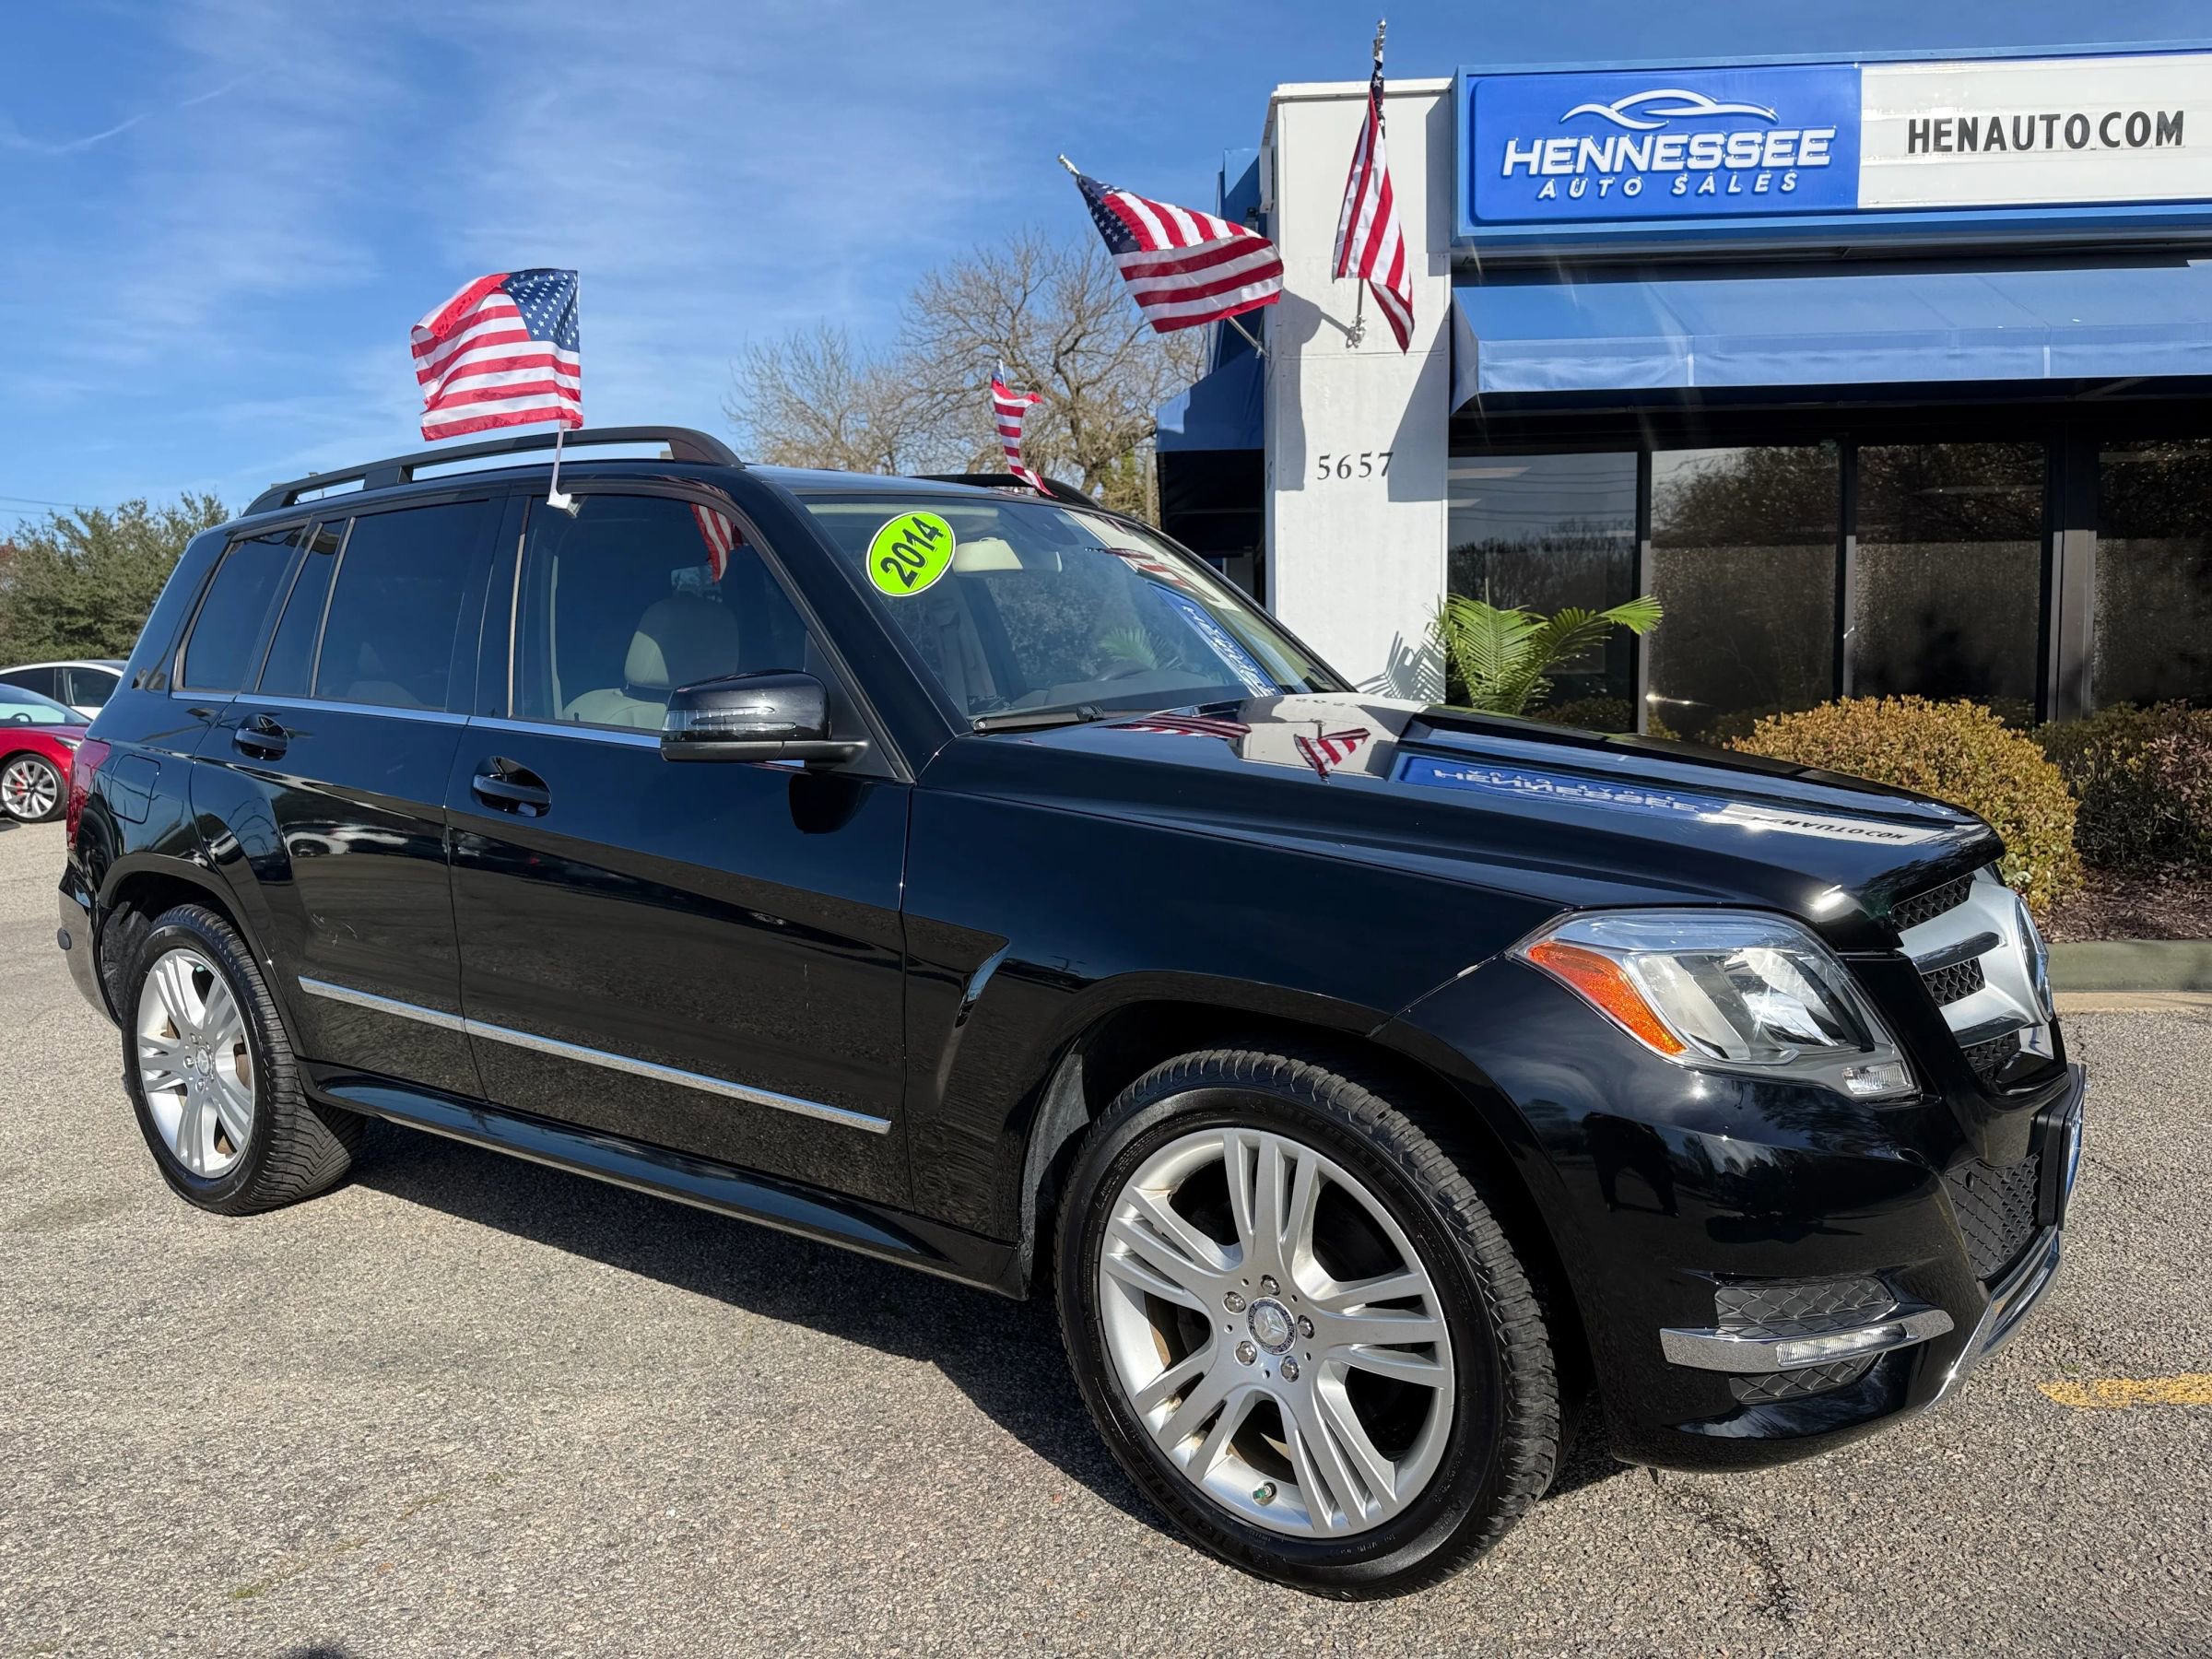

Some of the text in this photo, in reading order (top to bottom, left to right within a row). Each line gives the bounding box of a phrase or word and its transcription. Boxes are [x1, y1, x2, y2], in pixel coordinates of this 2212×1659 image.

[1501, 126, 1836, 176] HENNESSEE
[1907, 110, 2184, 154] HENAUTO.COM
[1536, 171, 1798, 199] AUTO SALES
[1316, 451, 1394, 480] 5657
[880, 516, 945, 589] 2014
